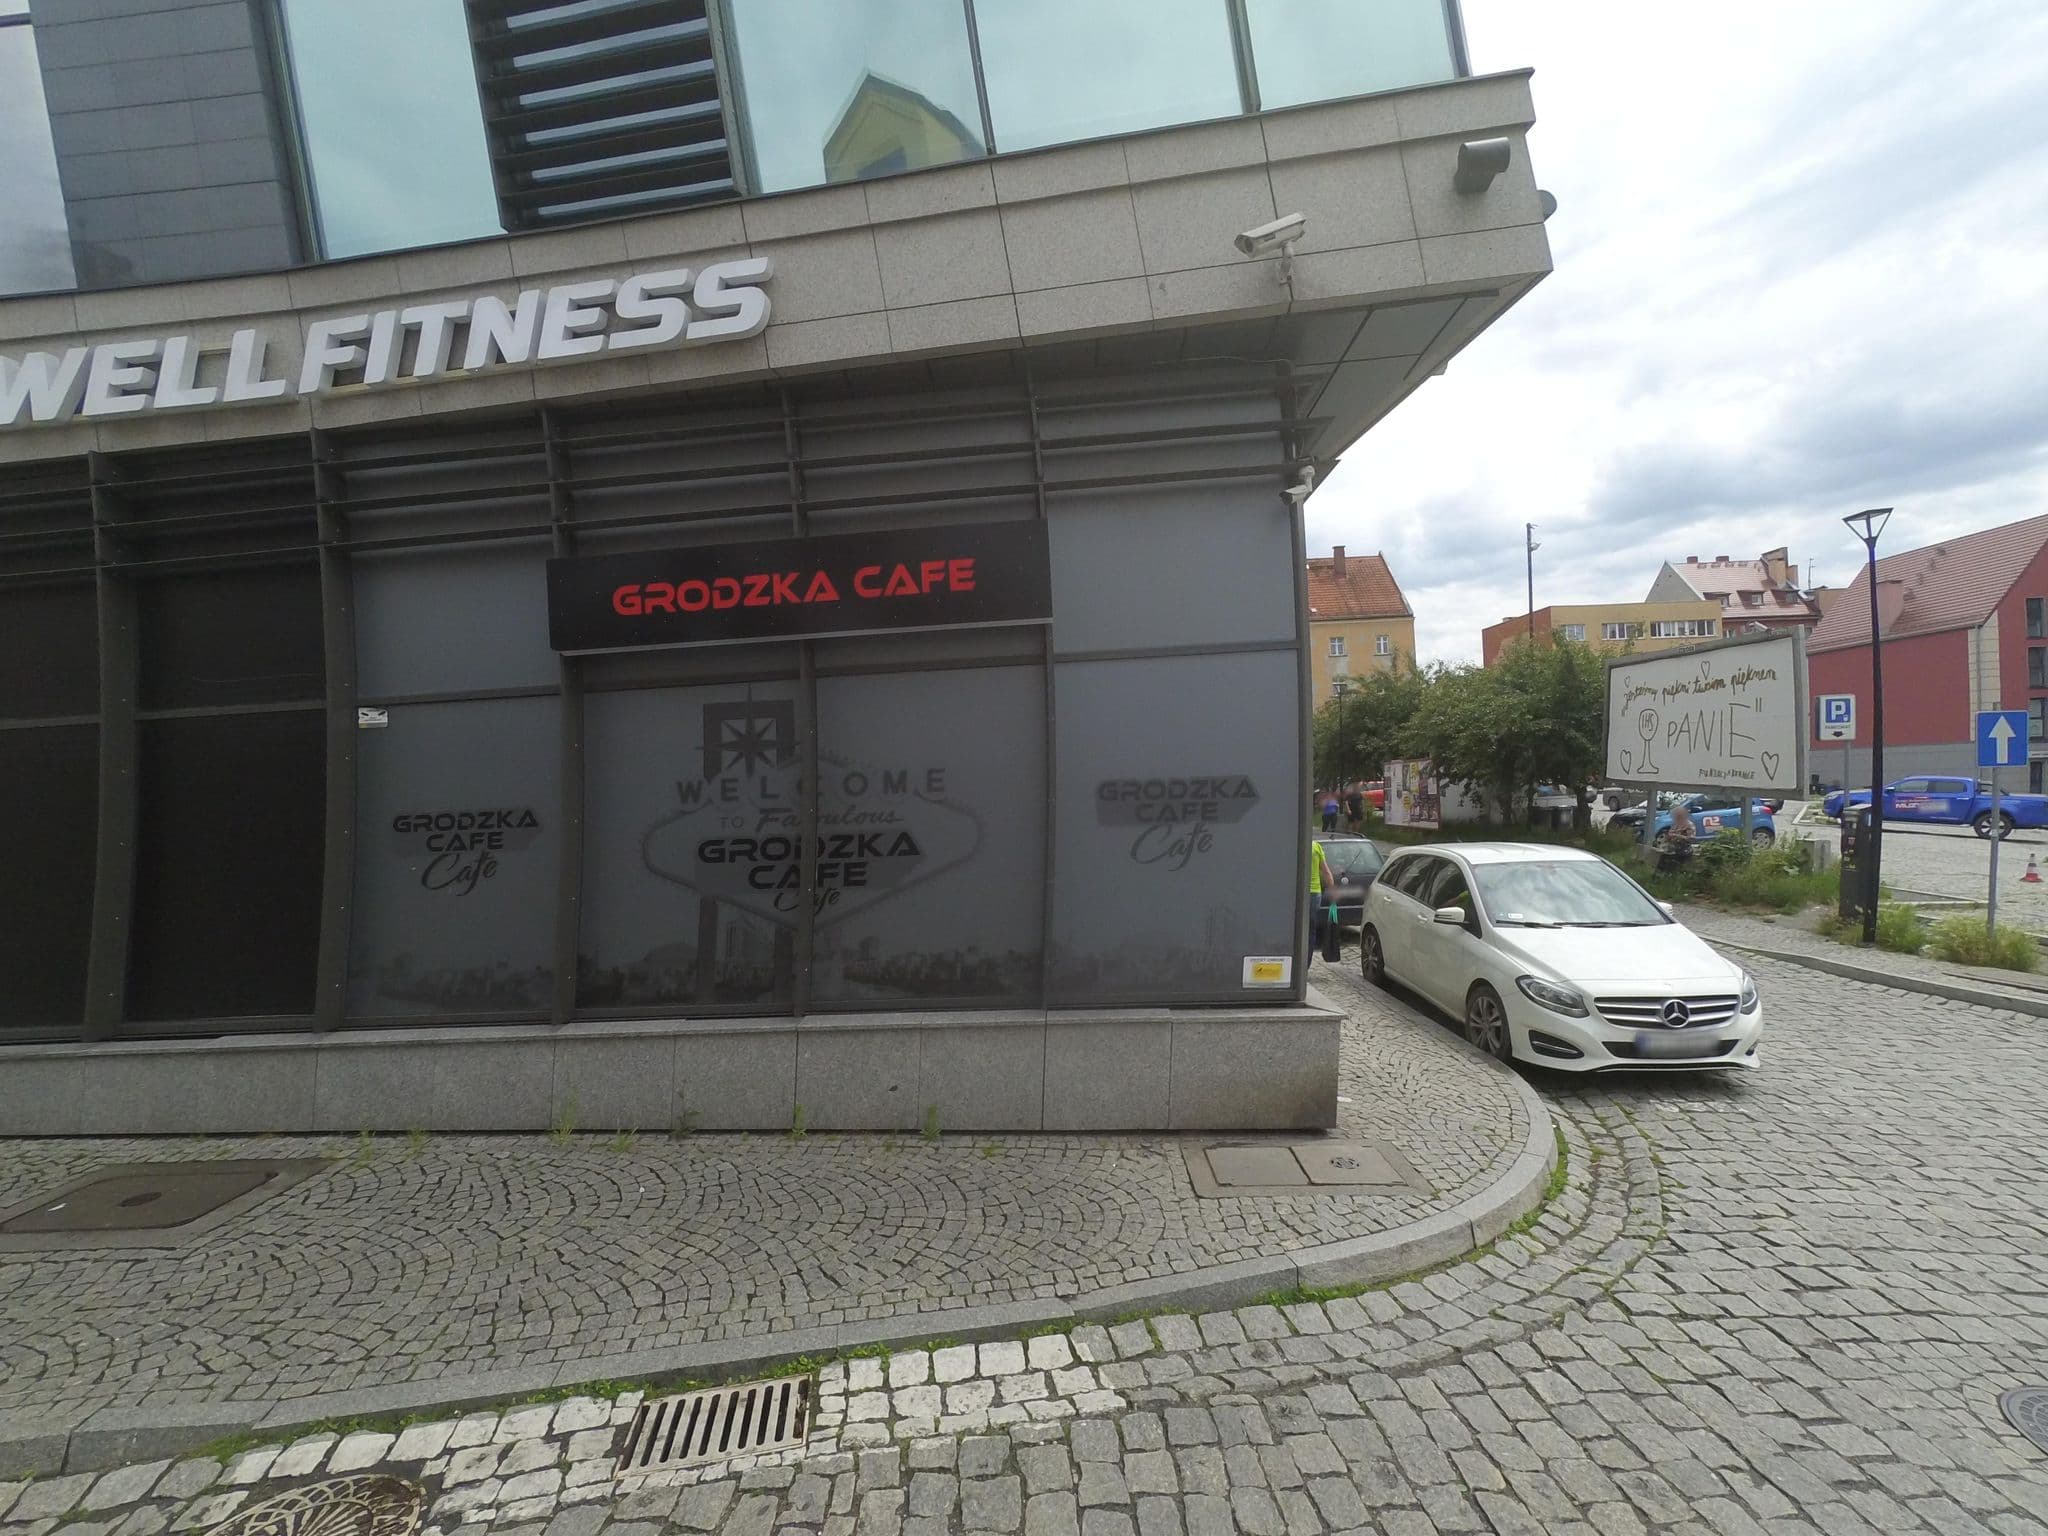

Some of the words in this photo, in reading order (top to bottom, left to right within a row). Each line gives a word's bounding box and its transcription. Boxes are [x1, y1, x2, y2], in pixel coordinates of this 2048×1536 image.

[0, 329, 287, 425] WELL
[298, 257, 773, 394] FITNESS
[613, 573, 841, 616] GRODZKA
[854, 558, 977, 598] CAFE
[1831, 701, 1846, 720] P
[1099, 777, 1257, 800] GRODZKA
[393, 808, 539, 832] GRODZKA
[756, 804, 904, 832] Faulous
[1135, 801, 1219, 822] CAFE
[426, 832, 504, 851] CAFE
